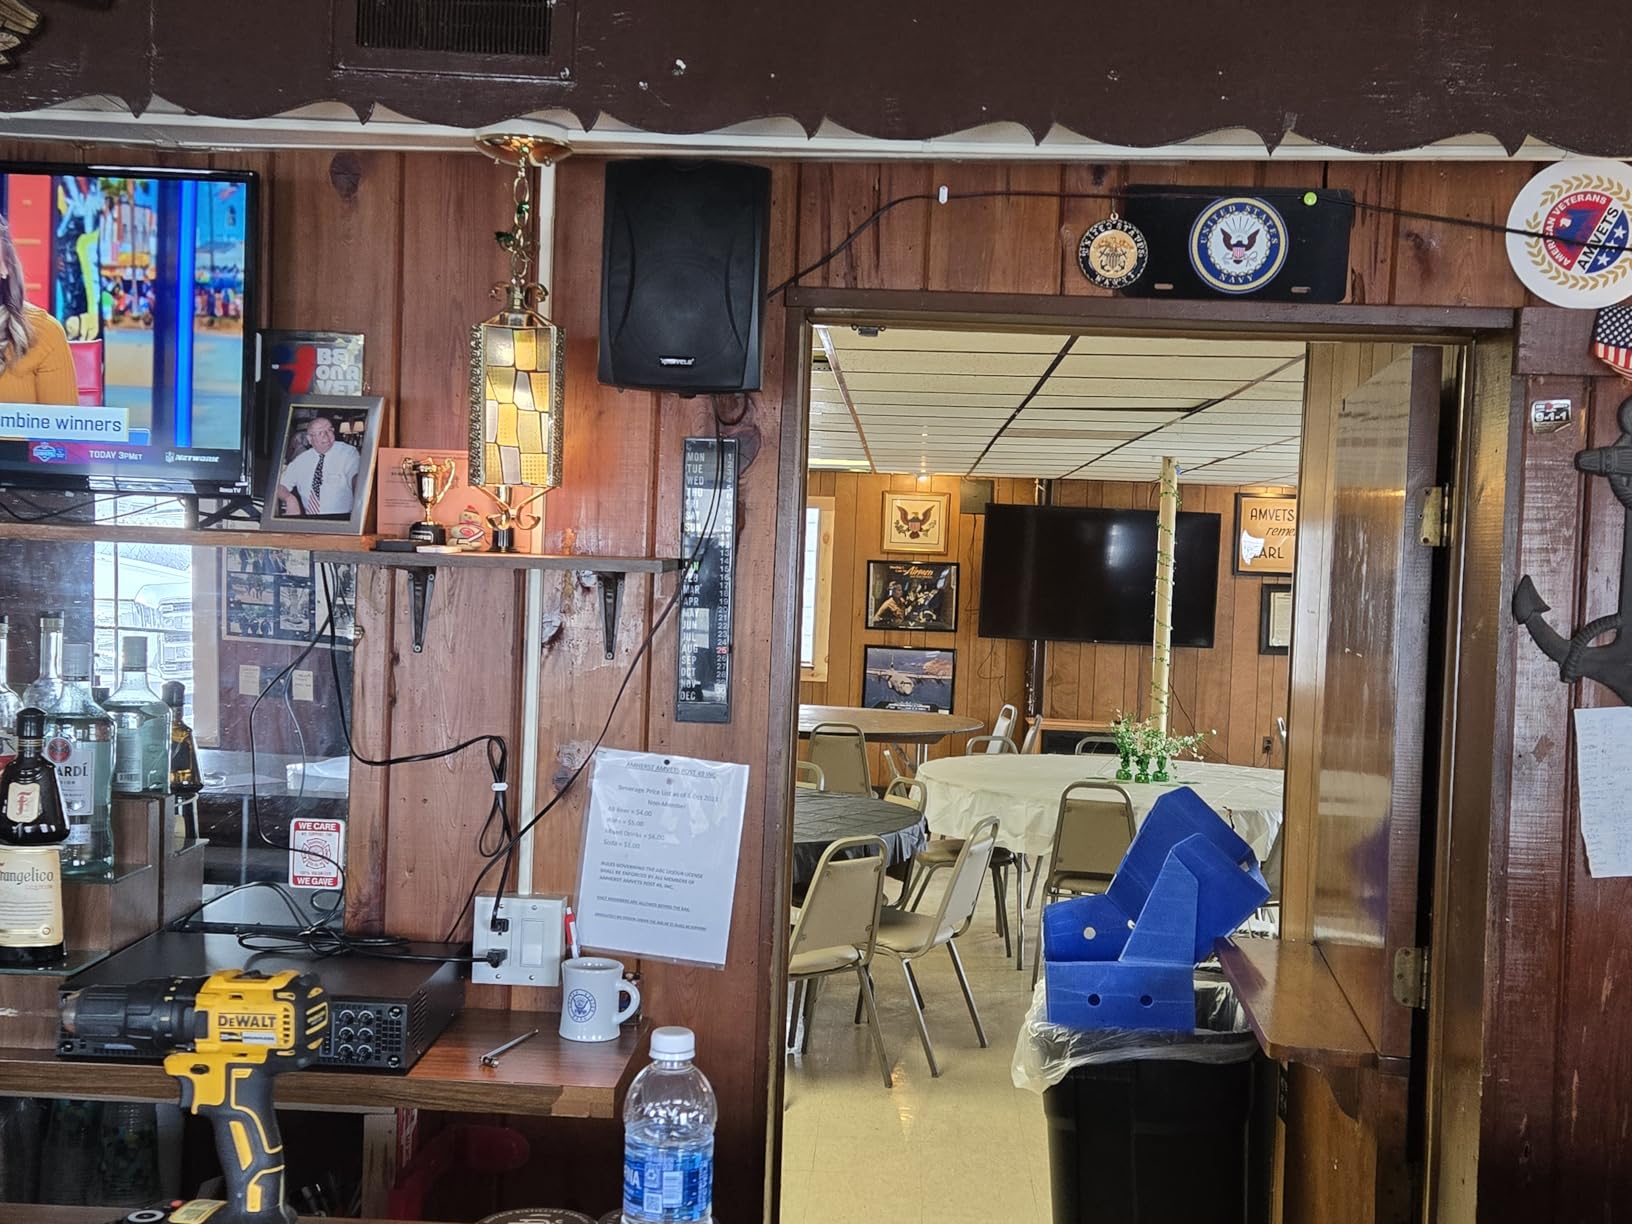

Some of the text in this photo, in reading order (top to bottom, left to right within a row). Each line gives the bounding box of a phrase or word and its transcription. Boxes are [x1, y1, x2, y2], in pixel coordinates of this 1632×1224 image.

[1553, 193, 1607, 216] VETERANS
[1200, 205, 1278, 244] UNITED STATES
[1577, 206, 1619, 270] AMVETS
[1219, 273, 1253, 284] NAVY
[316, 380, 358, 395] VET
[1535, 411, 1567, 422] 9-1-1
[0, 412, 122, 432] mbine winners
[89, 450, 116, 459] TODAY
[687, 453, 704, 461] MON
[687, 464, 703, 473] TUE
[687, 476, 704, 485] WED
[1250, 508, 1295, 522] AMVETS
[685, 523, 700, 532] SUN
[1266, 526, 1296, 537] reme
[1253, 546, 1285, 559] ARL
[683, 584, 700, 594] MAR
[683, 597, 699, 606] APR
[683, 620, 697, 630] JUN
[682, 644, 699, 653] AUG
[681, 655, 697, 664] SEP
[681, 668, 696, 677] OCT
[681, 679, 696, 688] NOV
[680, 691, 696, 700] DEC
[298, 822, 336, 831] WE CARE
[684, 871, 703, 879] LICENSE
[296, 877, 334, 886] WE GAVE
